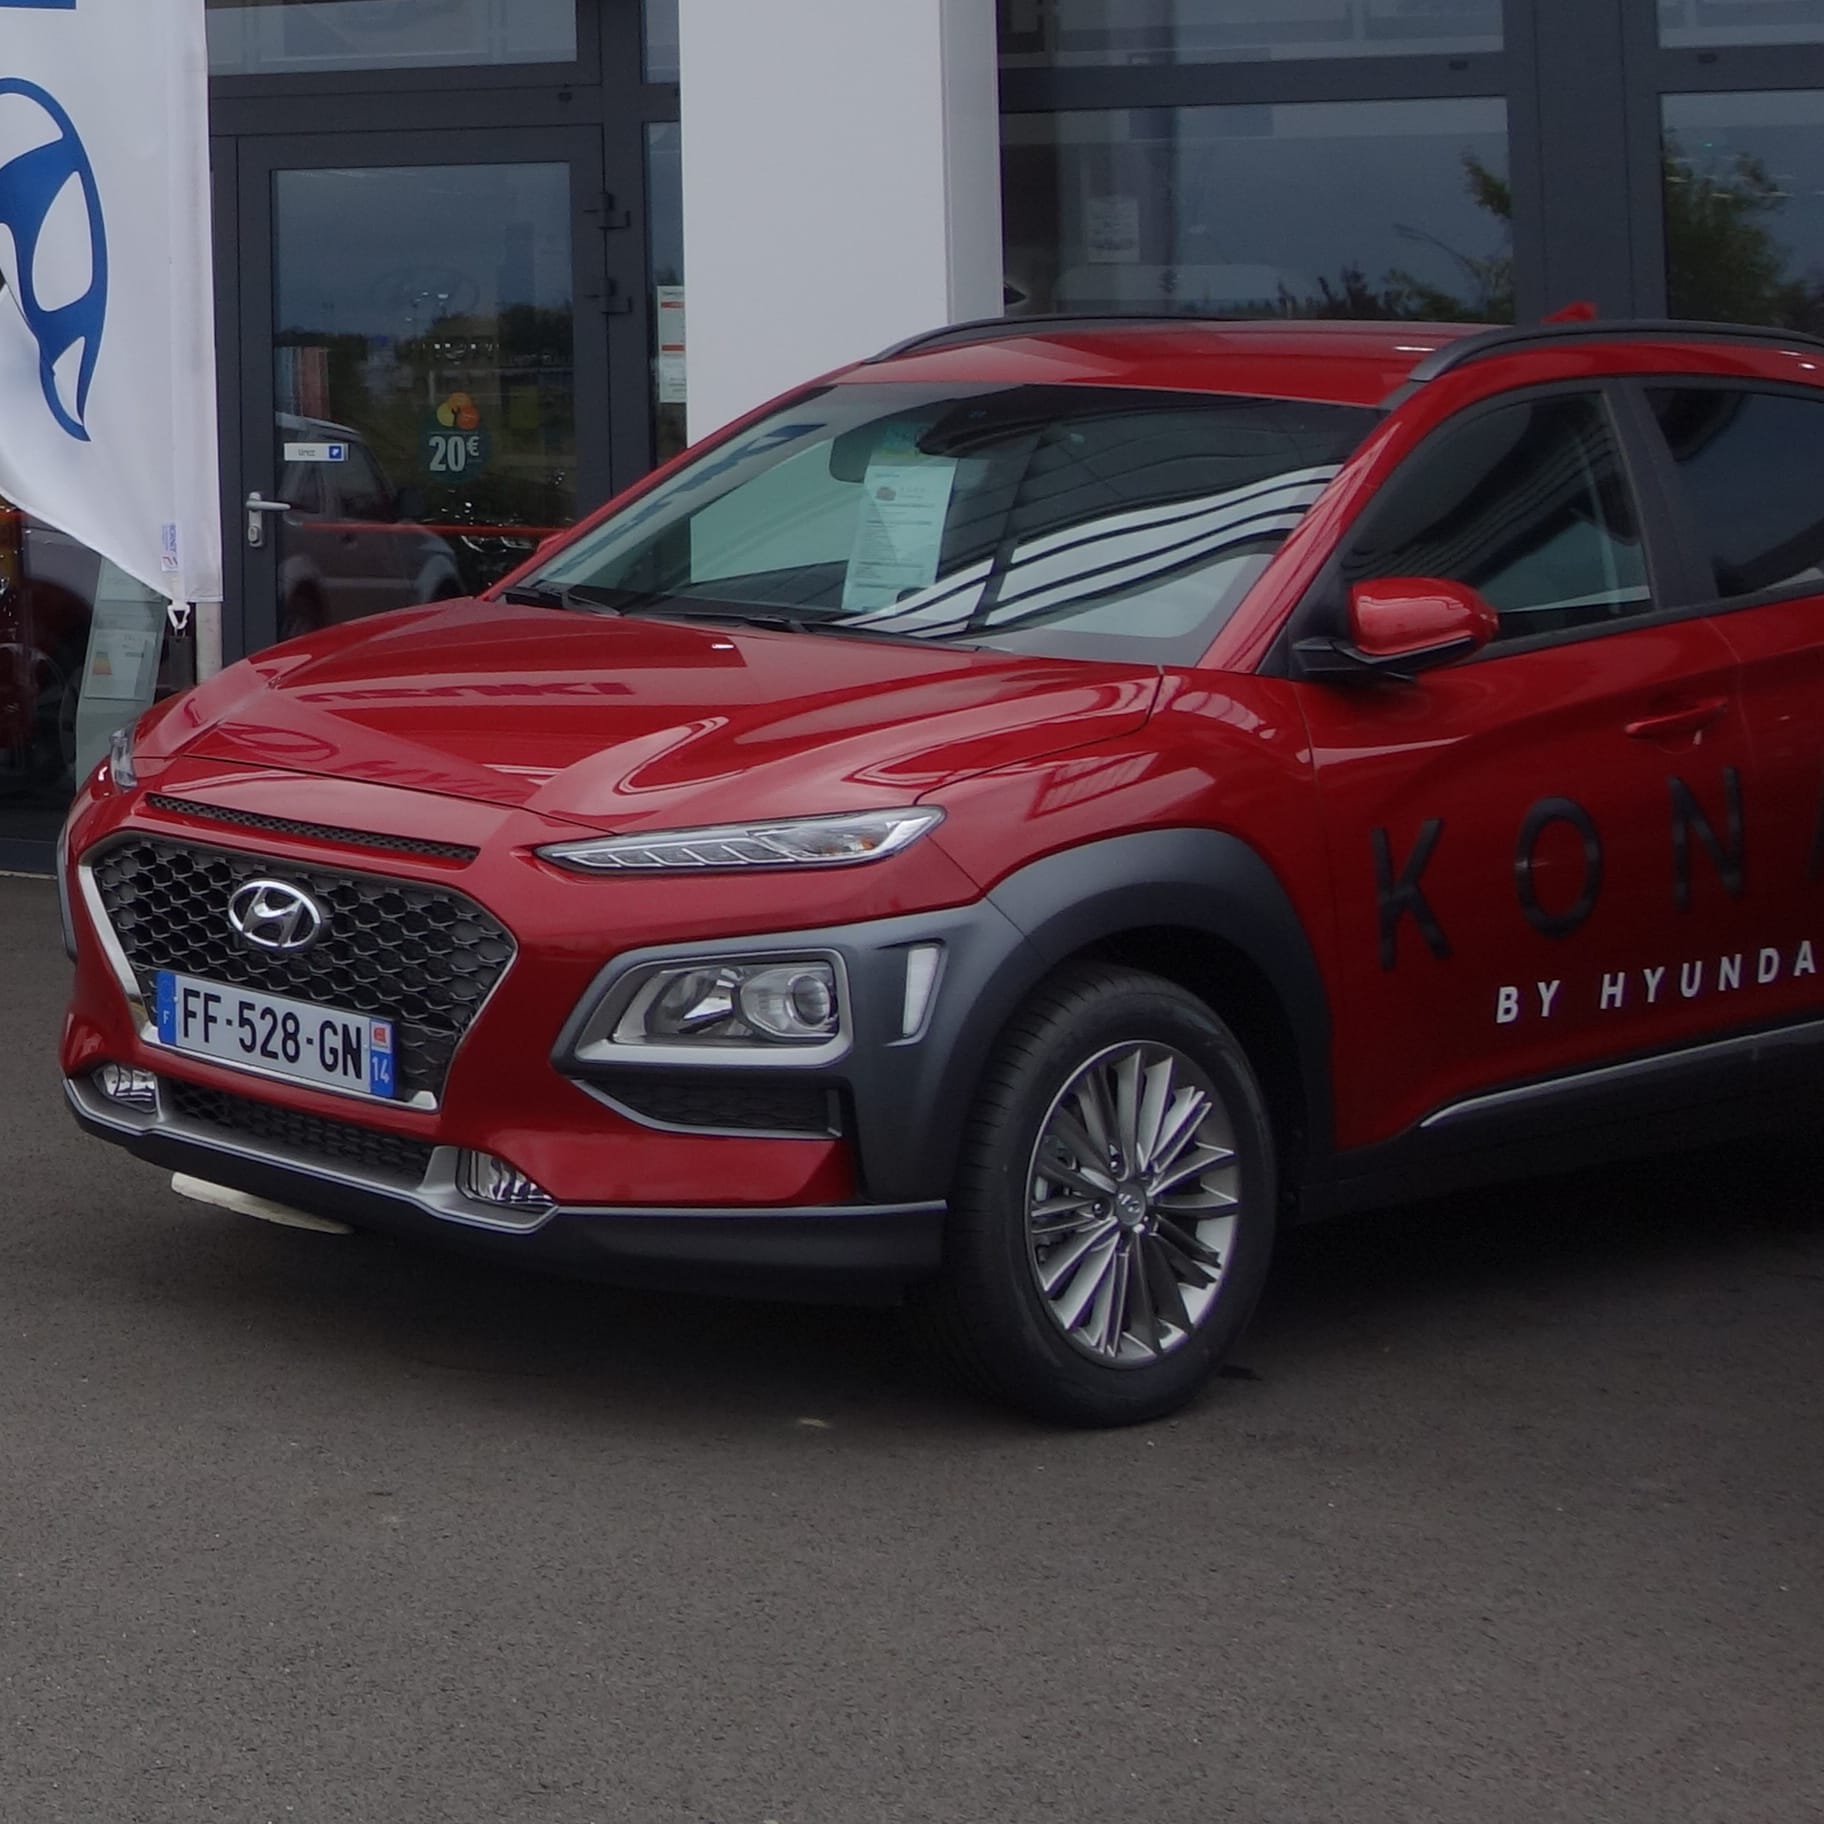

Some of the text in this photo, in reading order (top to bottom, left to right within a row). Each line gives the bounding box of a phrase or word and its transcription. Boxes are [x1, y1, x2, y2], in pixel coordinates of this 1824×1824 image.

[429, 436, 480, 472] 20€
[1371, 766, 1824, 971] KON
[1495, 941, 1816, 1024] BY HYUNDA
[163, 1010, 170, 1024] F
[183, 988, 363, 1079] FF-528-GN
[372, 1056, 390, 1084] 14
